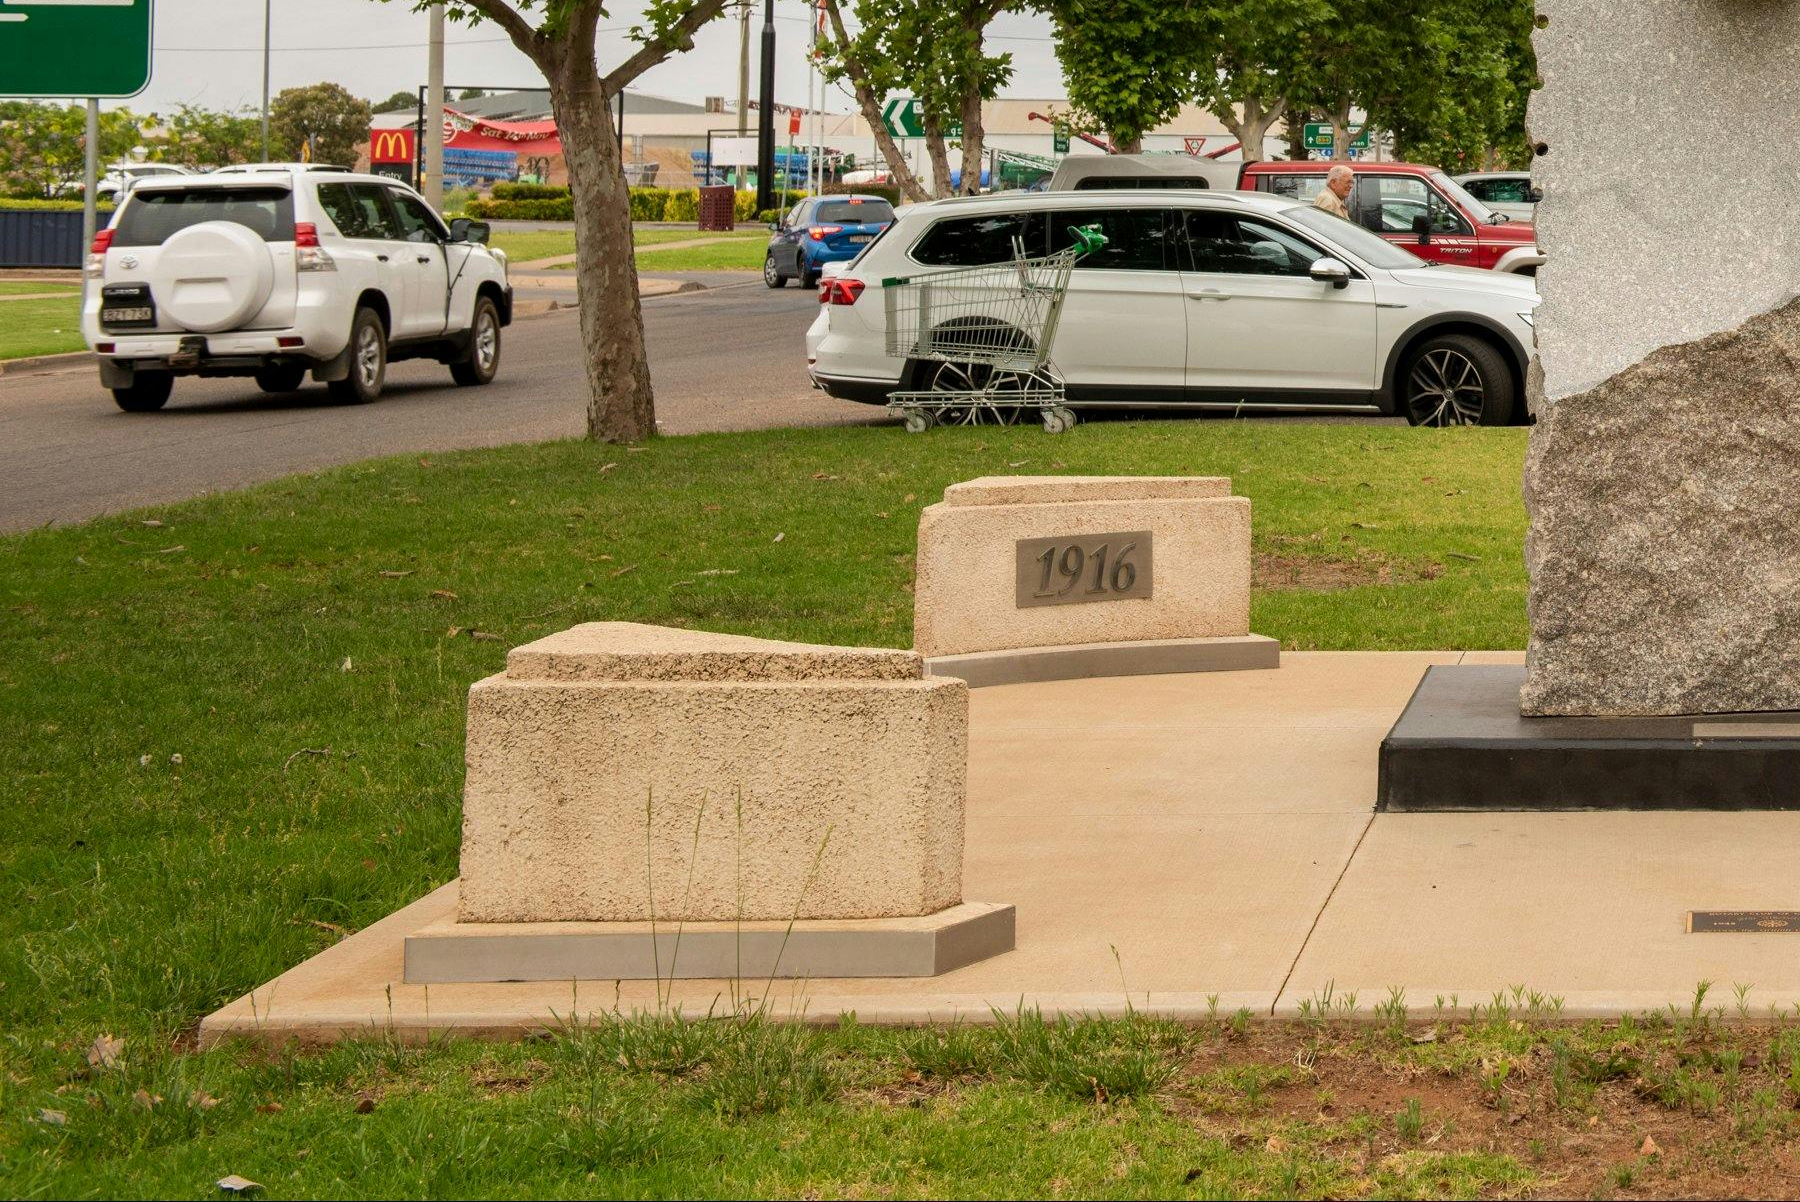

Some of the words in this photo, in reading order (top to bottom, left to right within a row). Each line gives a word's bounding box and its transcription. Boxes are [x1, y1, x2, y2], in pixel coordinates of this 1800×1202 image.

[480, 126, 502, 138] Sat
[378, 170, 402, 181] Entry
[1032, 541, 1137, 598] 1916
